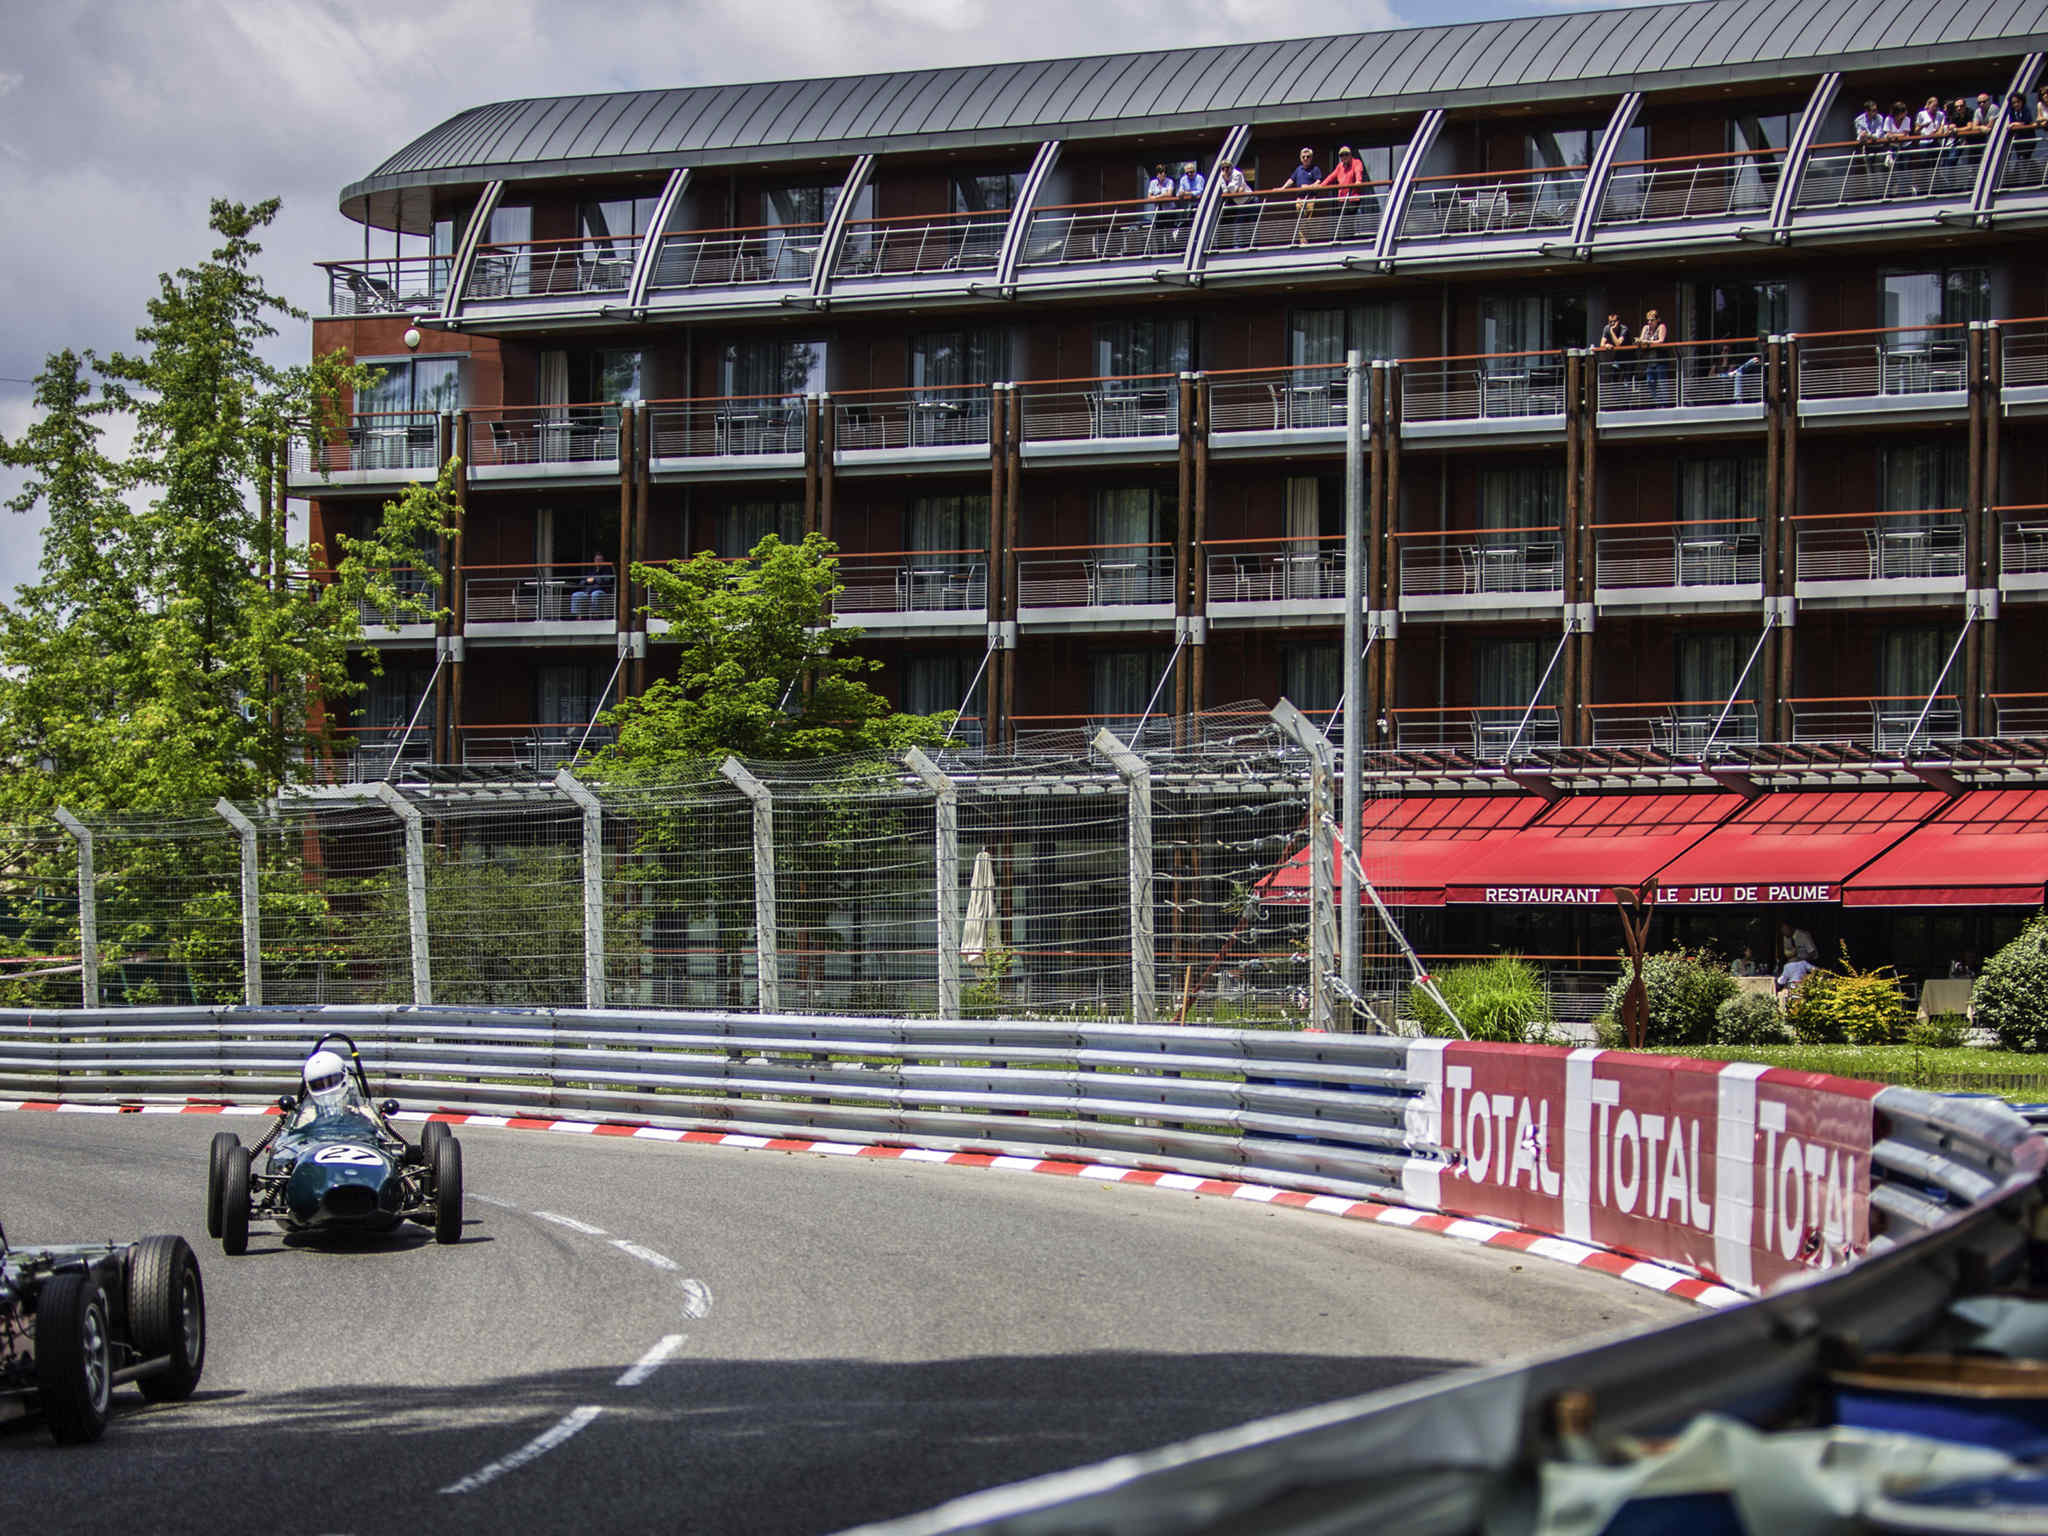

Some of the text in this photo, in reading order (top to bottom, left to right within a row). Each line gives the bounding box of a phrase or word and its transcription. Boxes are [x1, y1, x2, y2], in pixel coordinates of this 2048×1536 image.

[1486, 885, 1830, 903] RESTAURANT LE JEU DE PAUME
[320, 1147, 378, 1161] 27
[1446, 1065, 1560, 1196] TOTAL
[1592, 1078, 1711, 1232] TOTAL
